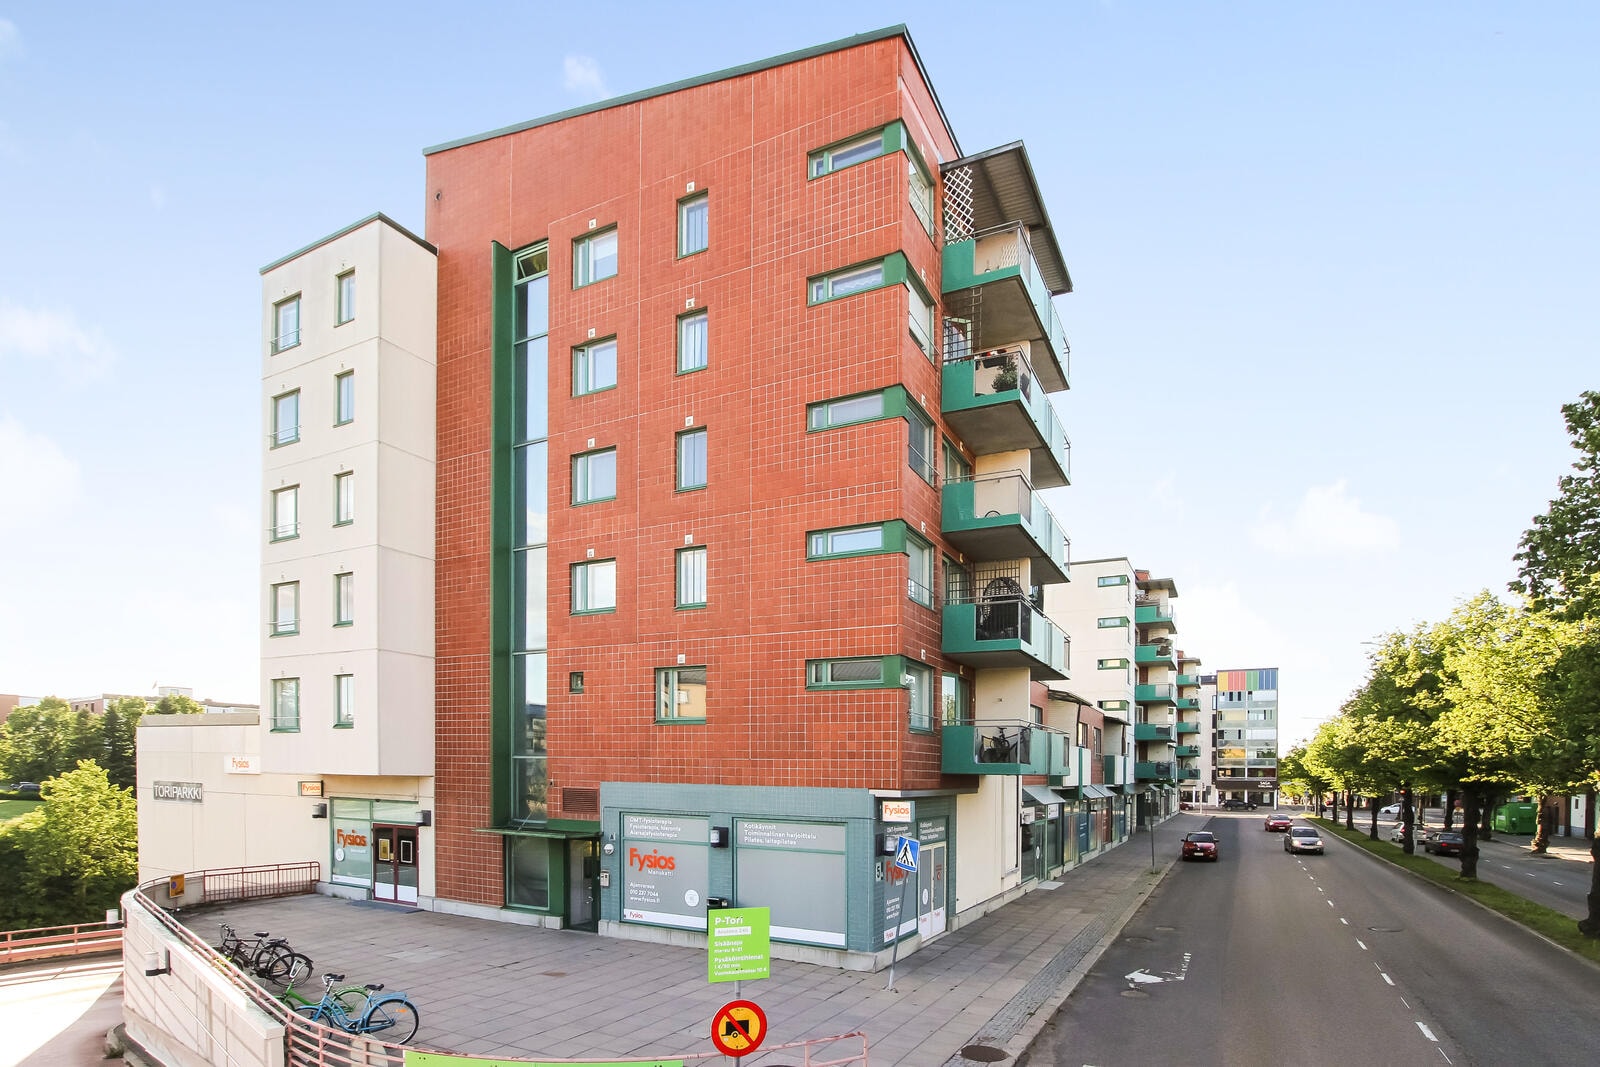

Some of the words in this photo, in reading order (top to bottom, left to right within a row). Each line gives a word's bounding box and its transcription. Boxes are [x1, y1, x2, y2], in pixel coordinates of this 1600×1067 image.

[154, 784, 202, 799] TORIPARKKI
[302, 783, 320, 792] Fysios
[884, 804, 910, 816] Fysios
[336, 828, 368, 848] Fysios
[744, 829, 786, 837] Toiminnallinen
[787, 831, 817, 840] harjoittelu
[629, 847, 676, 872] Fysios
[715, 916, 743, 925] P-Tori
